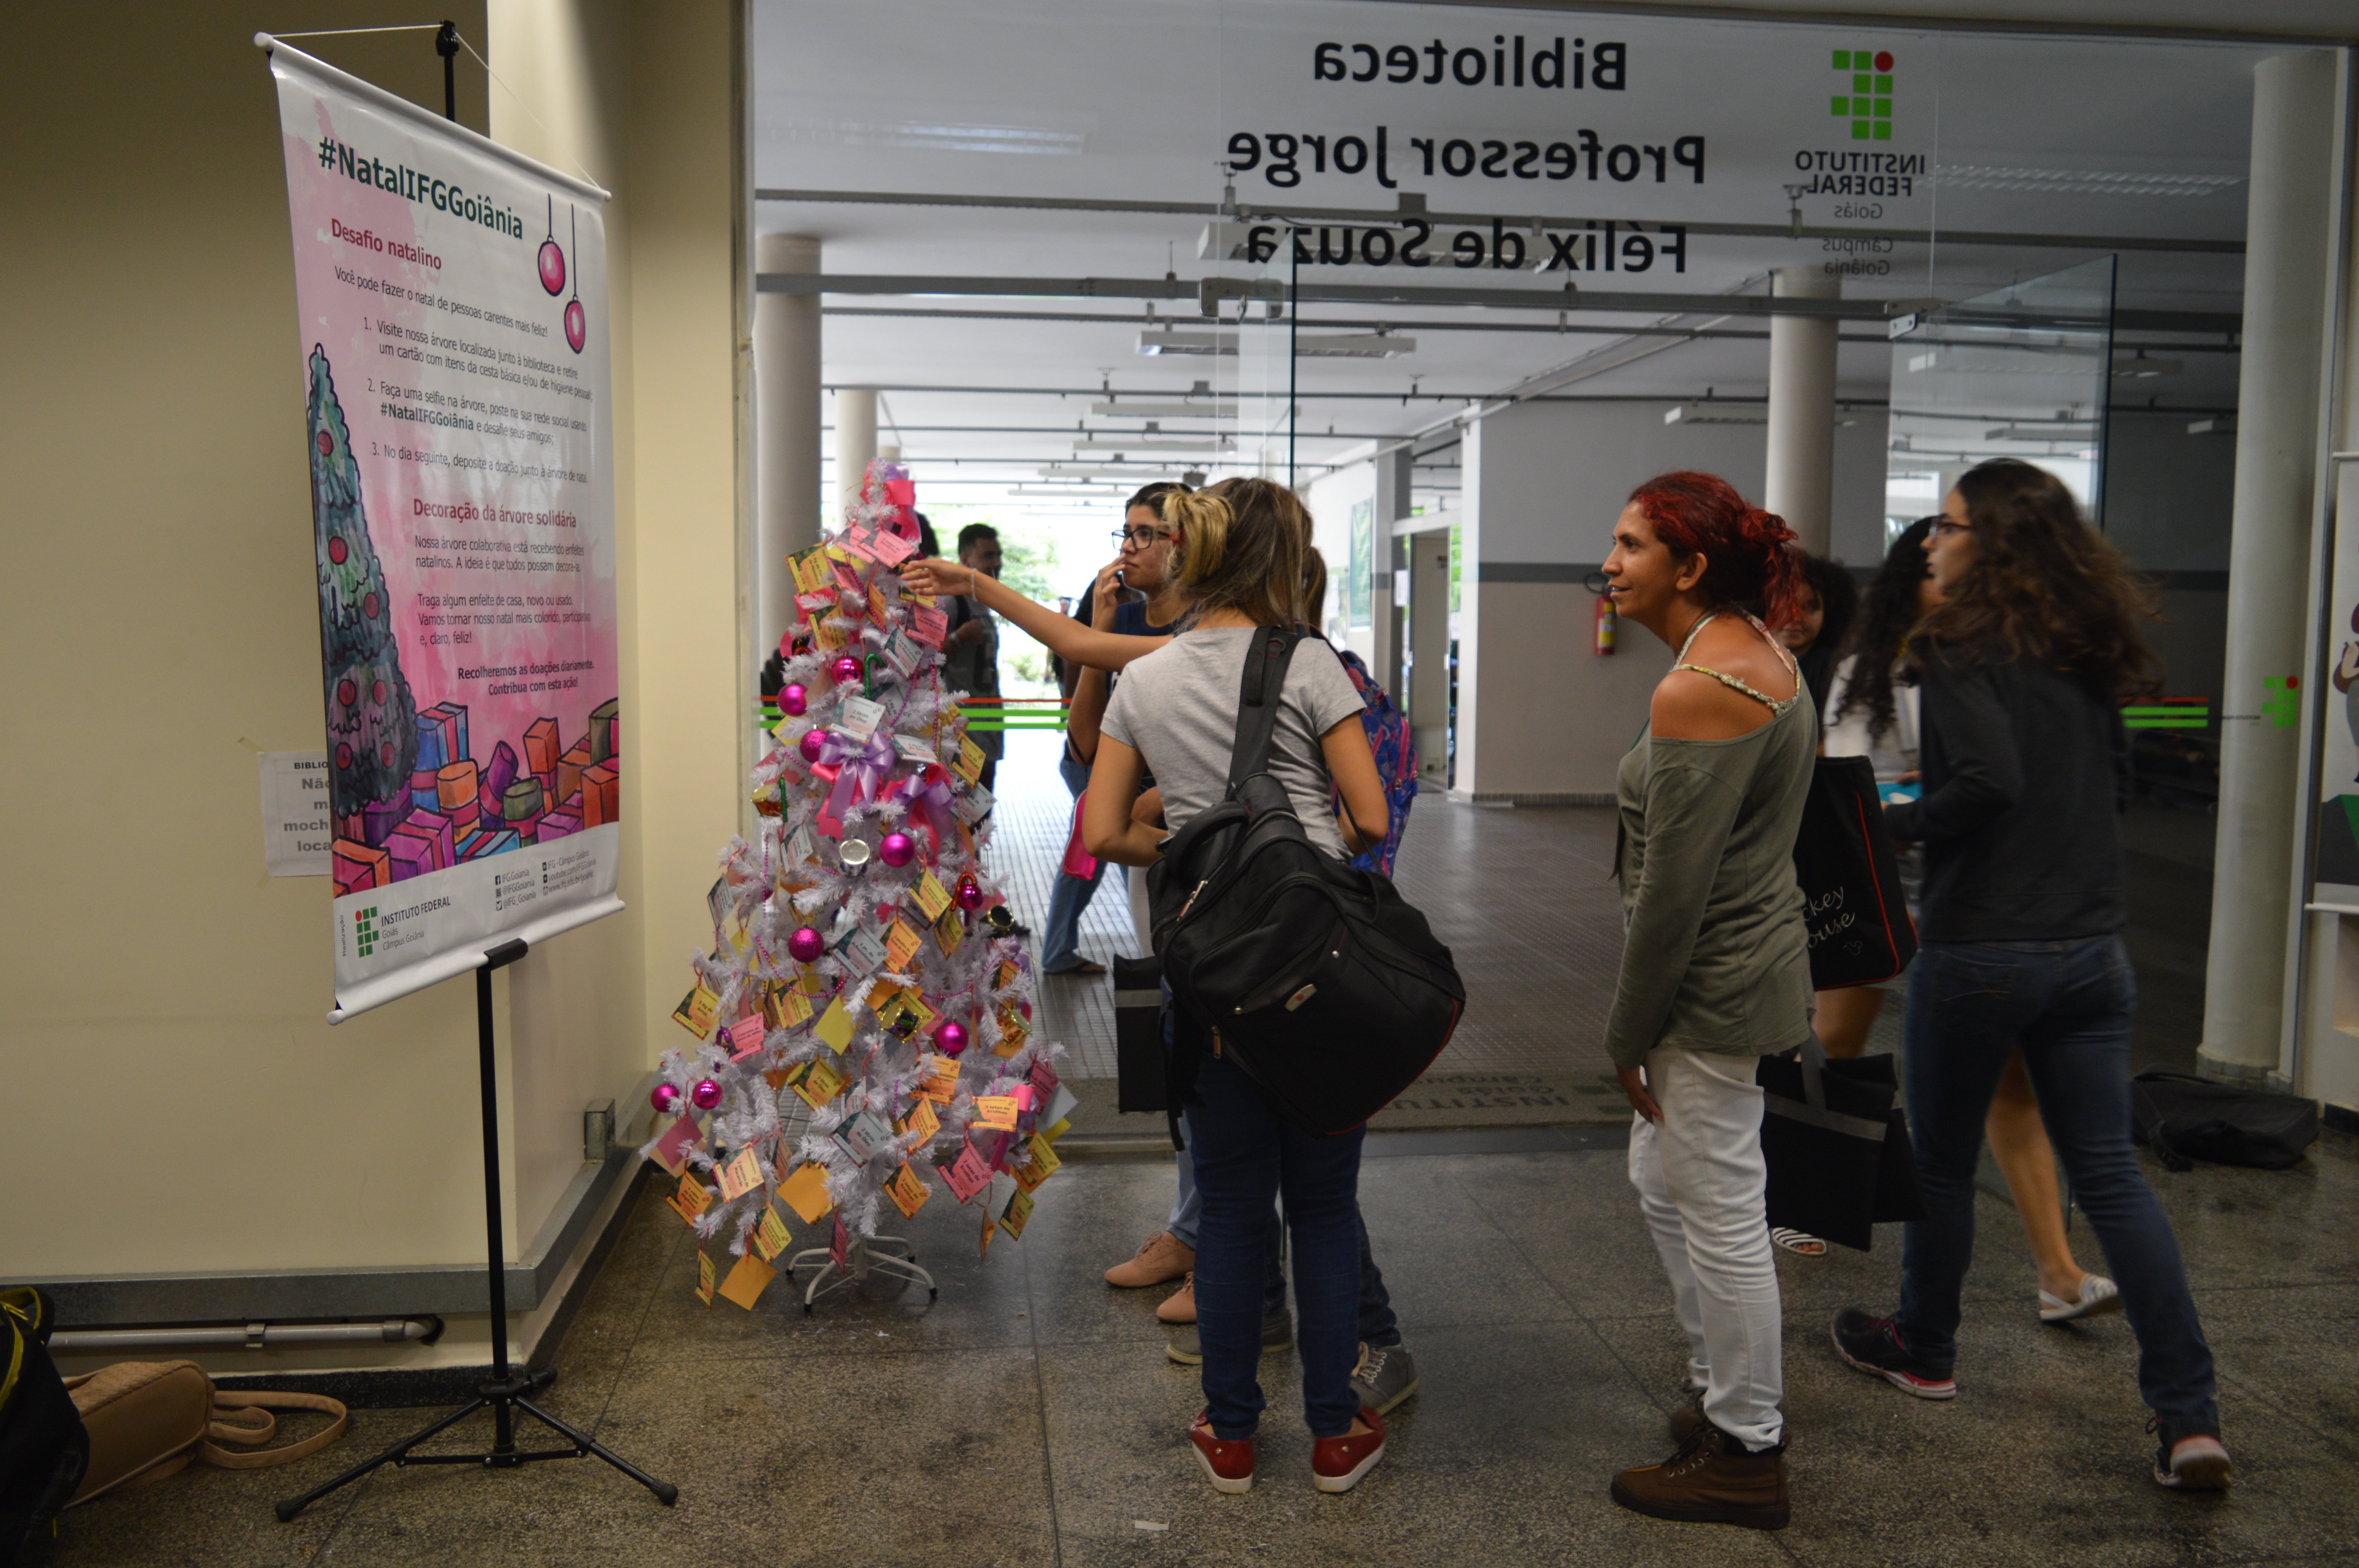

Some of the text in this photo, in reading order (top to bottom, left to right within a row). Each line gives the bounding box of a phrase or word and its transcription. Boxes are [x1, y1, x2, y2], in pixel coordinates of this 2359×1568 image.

[318, 137, 523, 240] #NatalIFGGoiânia
[331, 217, 442, 270] Desafio natalino
[335, 266, 548, 337] Você pode fazer o natal de pessoas carentes mais feliz!
[364, 317, 371, 330] 1.
[377, 319, 402, 337] Visite
[406, 329, 429, 343] nossa
[431, 332, 457, 350] árvore
[460, 339, 496, 359] localizada
[498, 349, 515, 364] junto
[523, 355, 555, 373] biblioteca
[557, 366, 561, 375] e
[380, 343, 394, 354] um
[397, 347, 424, 362] cartão
[427, 354, 443, 367] com
[445, 356, 465, 371] itens
[467, 361, 477, 373] da
[480, 365, 498, 378] cesta
[501, 368, 521, 383] básica
[523, 375, 538, 387] e/ou
[540, 377, 549, 389] de
[368, 378, 375, 392] 2.
[381, 381, 400, 399] Faça
[404, 388, 422, 400] uma
[425, 391, 445, 405] selfie
[447, 396, 457, 407] na
[461, 395, 487, 415] árvore,
[490, 404, 508, 416] poste
[511, 408, 518, 418] na
[521, 410, 532, 421] sua
[534, 412, 550, 423] rede
[552, 416, 569, 427] social
[380, 402, 473, 430] #NatalIFGGoiânia
[477, 422, 482, 431] e
[484, 421, 508, 436] desafie
[510, 428, 525, 439] seus
[373, 442, 379, 456] 3.
[384, 445, 395, 458] No
[399, 446, 411, 460] dia
[415, 451, 450, 467] seguinte,
[453, 454, 486, 470] deposite
[489, 461, 493, 470] a
[496, 460, 518, 475] doação
[521, 463, 539, 477] junto
[547, 466, 567, 479] árvore
[414, 499, 576, 528] Decoração da árvore solidária
[415, 535, 439, 548] Nossa
[442, 535, 467, 550] árvore
[469, 538, 511, 552] colaborativa
[514, 541, 528, 553] está
[531, 543, 564, 554] recebendo
[416, 555, 453, 568] natalinos.
[456, 557, 462, 568] A
[465, 557, 483, 568] ideia
[486, 556, 490, 568] é
[493, 559, 504, 572] que
[507, 559, 525, 570] todos
[528, 561, 553, 573] possam
[418, 594, 440, 609] Traga
[443, 593, 466, 609] algum
[469, 593, 494, 606] enfeite
[496, 594, 504, 606] de
[507, 596, 524, 608] casa,
[527, 596, 543, 605] novo
[547, 597, 554, 605] ou
[418, 613, 445, 625] Vamos
[447, 613, 471, 624] tornar
[474, 615, 494, 624] nosso
[497, 612, 513, 623] natal
[516, 612, 532, 623] mais
[420, 631, 472, 647] e, claro, feliz!
[458, 666, 516, 679] Recolheremos
[519, 666, 527, 675] as
[530, 661, 559, 675] doações
[489, 682, 527, 695] Contribua
[530, 682, 545, 691] com
[548, 679, 561, 690] esta
[381, 896, 451, 926] INSTITUTO FEDERAL
[382, 927, 398, 938] Goiás
[383, 931, 424, 950] Câmpus Goiânia
